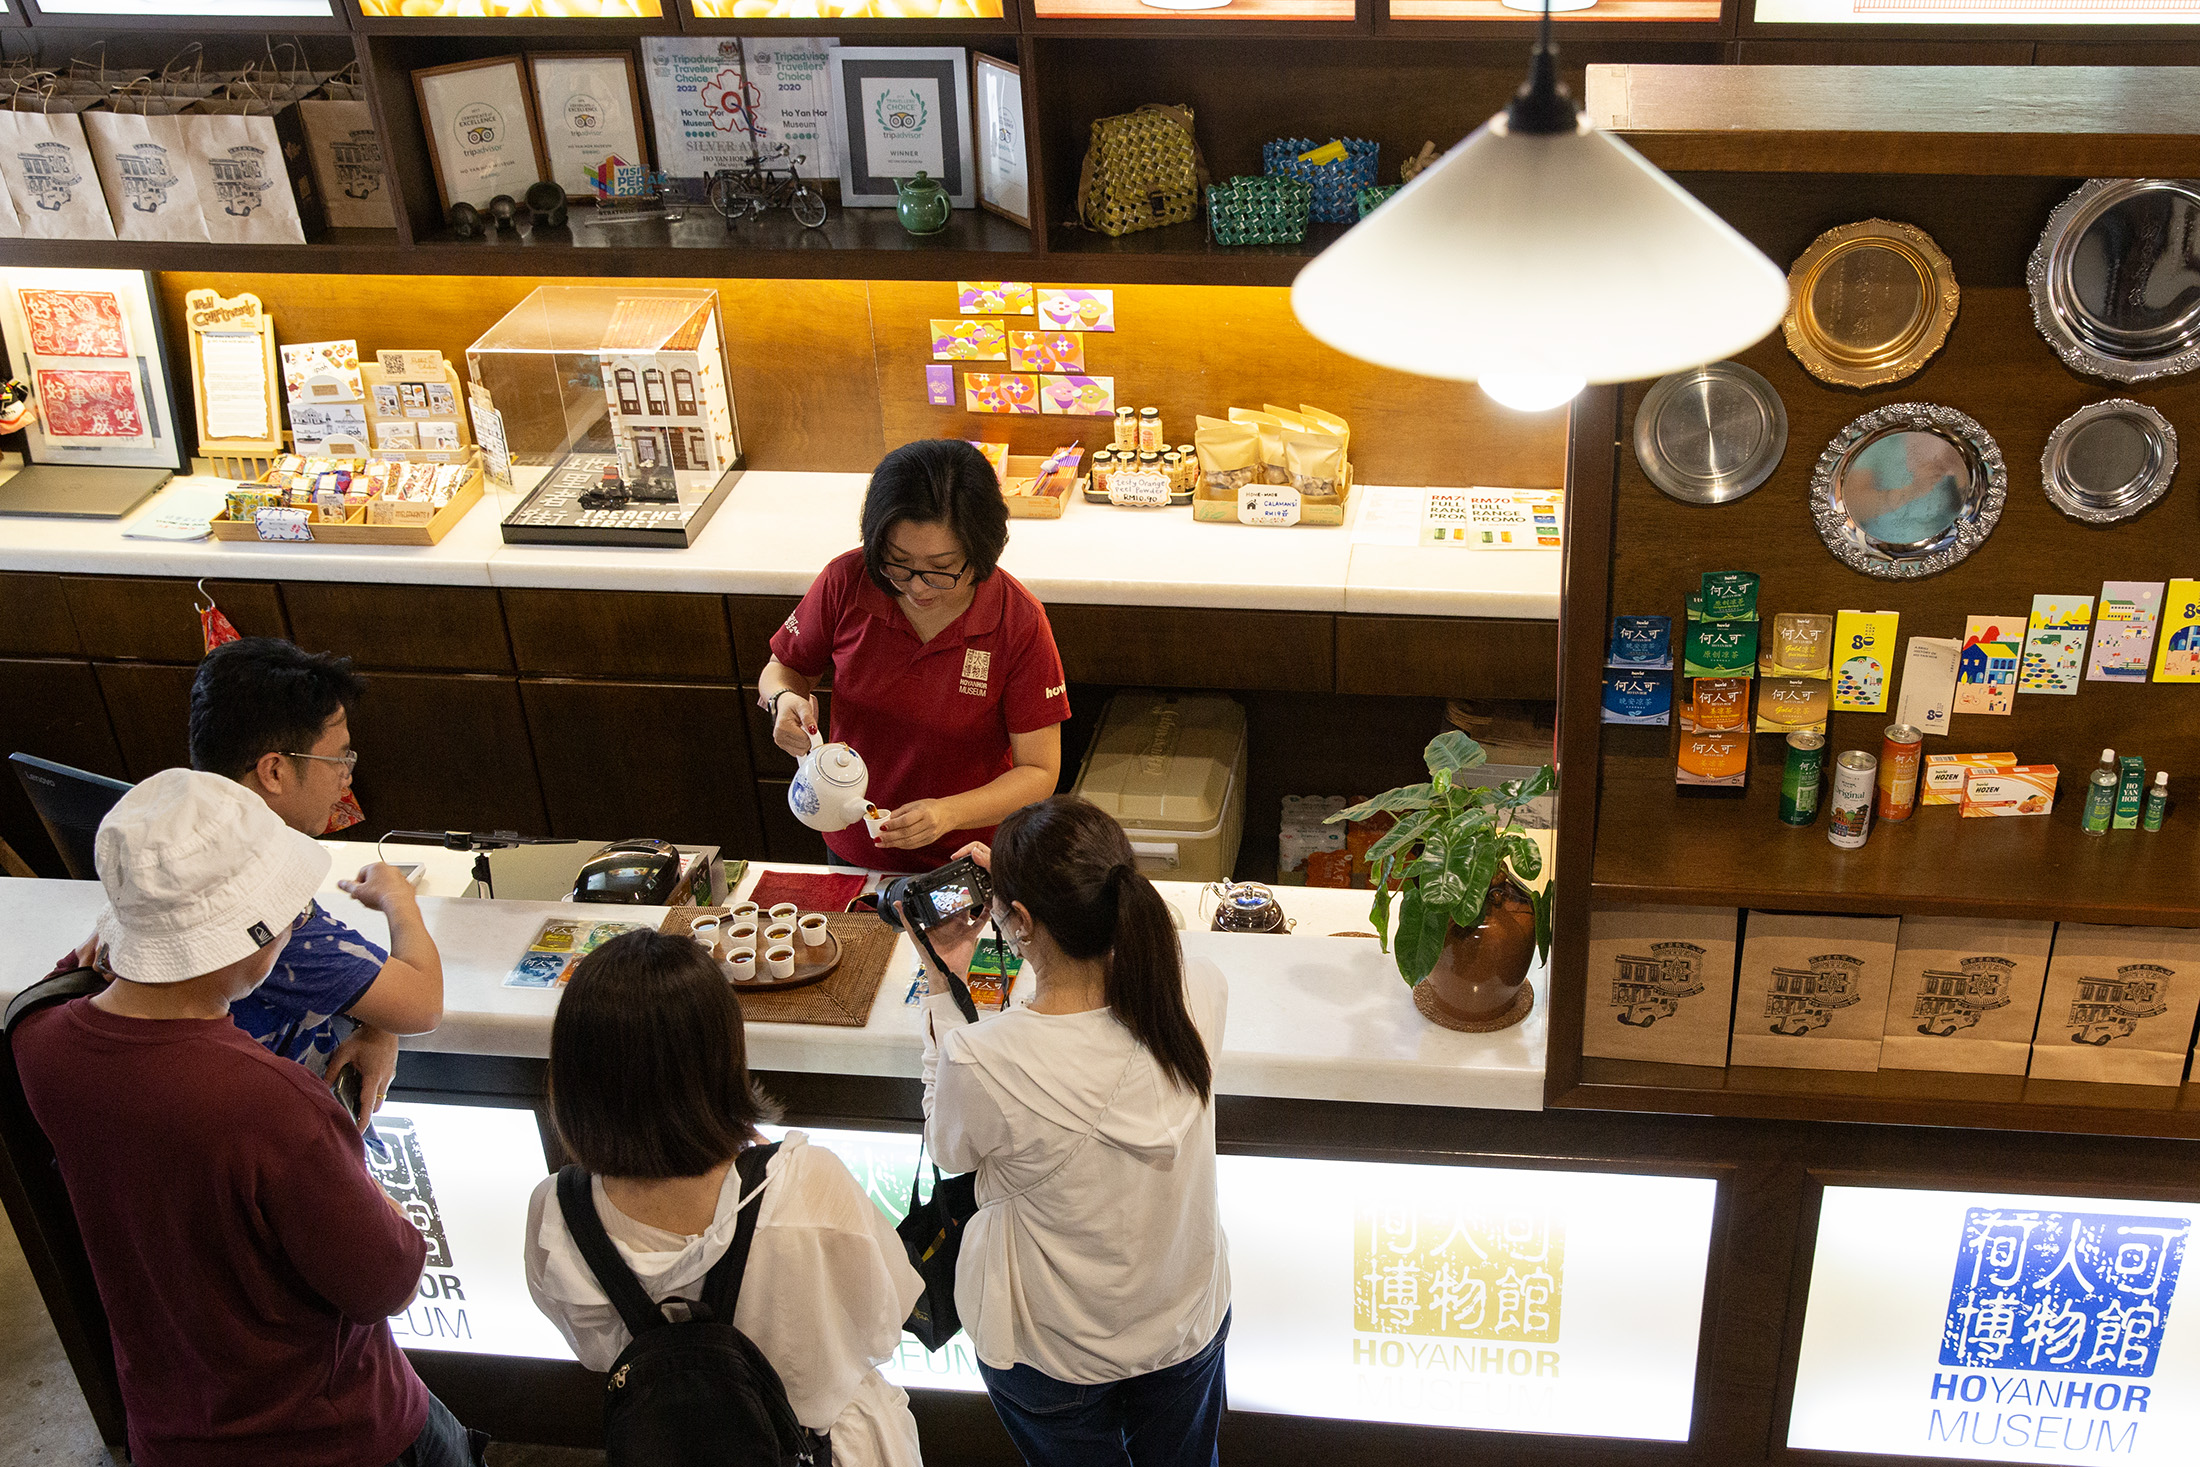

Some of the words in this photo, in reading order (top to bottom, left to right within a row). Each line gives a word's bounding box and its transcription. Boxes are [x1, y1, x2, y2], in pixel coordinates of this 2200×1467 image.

[672, 55, 724, 64] Tripadvisor
[774, 52, 829, 63] Tripadvisor
[675, 74, 708, 82] Choice
[777, 72, 812, 80] Choice
[459, 116, 496, 128] EXCELLENCE
[883, 132, 922, 140] tripadvisor
[464, 145, 502, 157] tripadvisor
[686, 141, 735, 151] SILVER
[739, 141, 788, 152] AWAR
[618, 167, 646, 176] VISIT
[618, 174, 668, 187] PERAK
[618, 186, 655, 197] 2024
[1139, 479, 1165, 488] Orange
[582, 510, 695, 521] TREACHER
[1710, 583, 1752, 596] 何人可
[1620, 628, 1660, 640] 何人可
[1699, 632, 1742, 644] 何人可
[1780, 628, 1822, 640] 何人可
[1852, 634, 1875, 650] 80
[960, 679, 988, 690] HOYANHOR
[1046, 680, 1066, 698] hovi
[1614, 680, 1656, 692] 何人可
[959, 686, 986, 697] MUSEUM
[1700, 691, 1740, 704] 何人可
[1772, 689, 1814, 701] 何人可
[1926, 710, 1944, 720] 80
[1692, 742, 1733, 754] 何人可
[24, 770, 56, 788] Lenovo
[1834, 785, 1865, 800] Original
[1968, 1212, 2190, 1296] 何人可
[1362, 1258, 1555, 1335] 博物館
[1955, 1291, 2159, 1370] 博物館
[1353, 1338, 1560, 1378] HOYANHOR
[1930, 1373, 2151, 1413] HOYANHOR
[1927, 1409, 2139, 1454] MUSEUM
